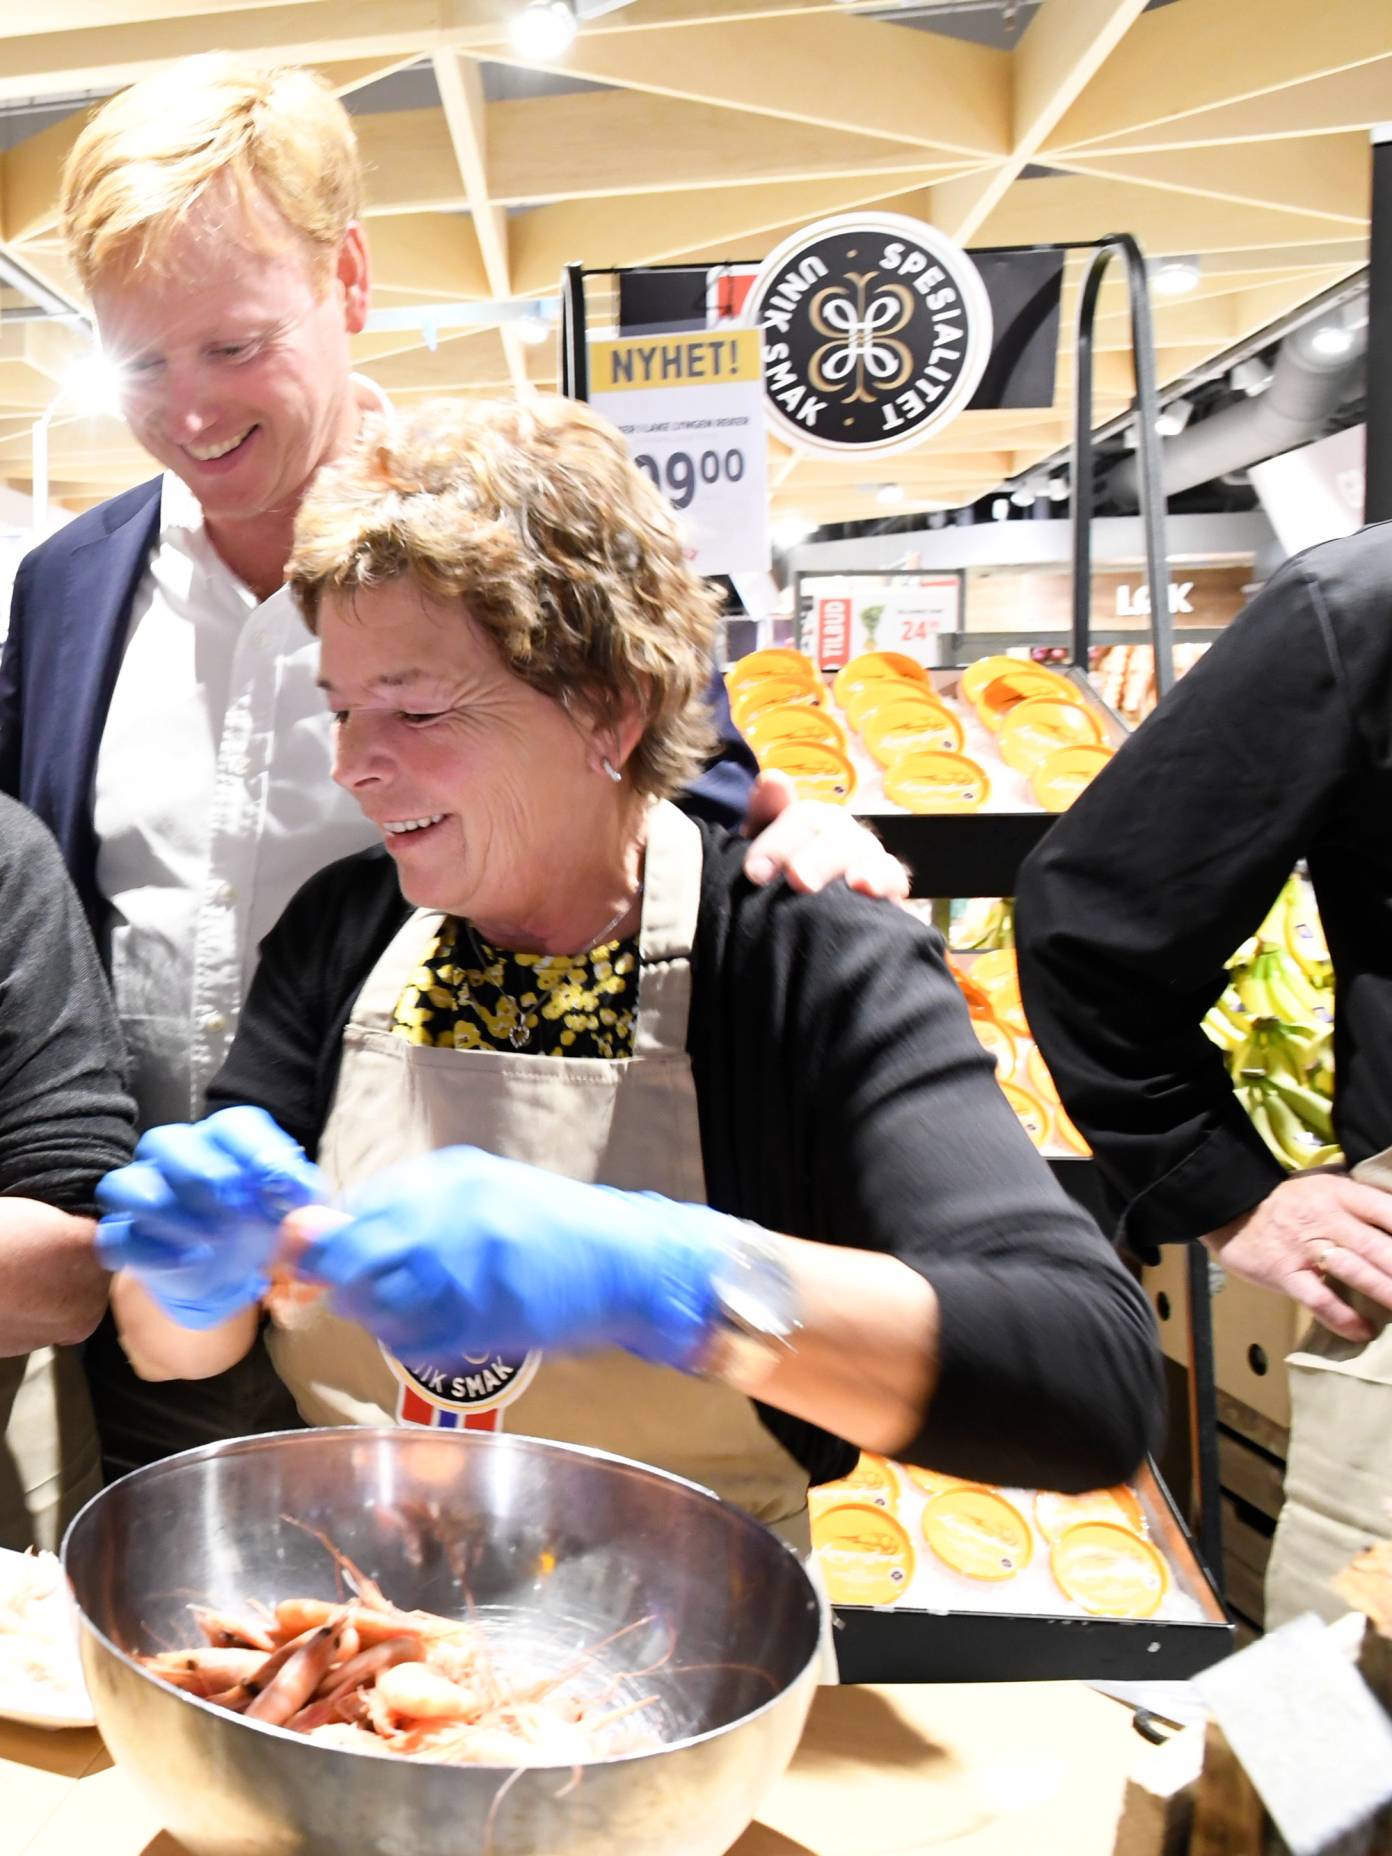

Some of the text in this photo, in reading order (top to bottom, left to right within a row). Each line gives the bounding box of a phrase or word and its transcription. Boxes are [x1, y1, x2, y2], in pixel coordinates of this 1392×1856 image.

[612, 339, 738, 384] NYHET!
[762, 255, 829, 427] UNIK SMAK
[878, 242, 964, 431] SPESIALITET
[821, 600, 847, 658] TILBUD
[451, 1354, 514, 1399] SMAK
